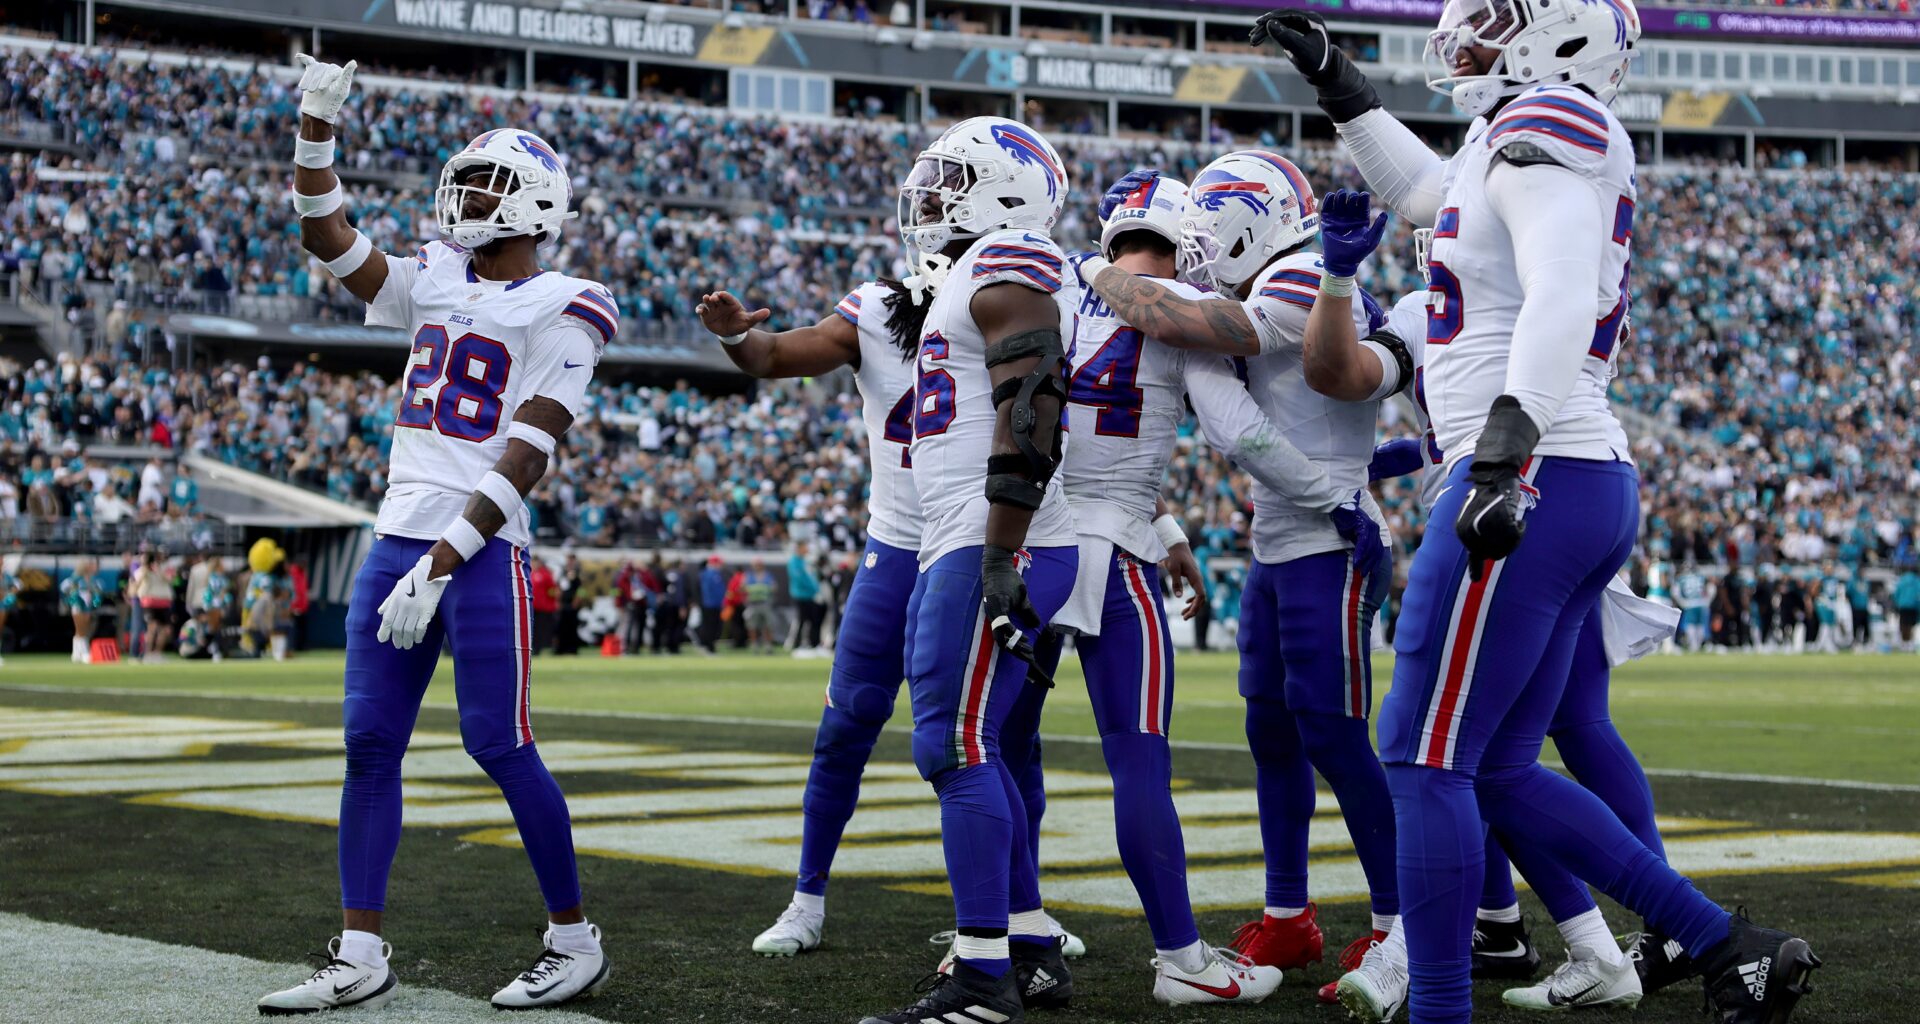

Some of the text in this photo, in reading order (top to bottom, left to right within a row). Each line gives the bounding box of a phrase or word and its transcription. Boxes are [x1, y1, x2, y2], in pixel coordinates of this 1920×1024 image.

[469, 2, 515, 36] AND
[518, 7, 609, 46] DELORES
[612, 17, 695, 55] WEAVER
[1037, 57, 1092, 88] MARK
[1094, 62, 1173, 96] BRUNELL
[1111, 209, 1147, 224] BILLS
[448, 314, 474, 326] BILLS
[395, 323, 513, 443] 28
[1026, 978, 1057, 992] adidas
[1754, 956, 1771, 1001] adidas
